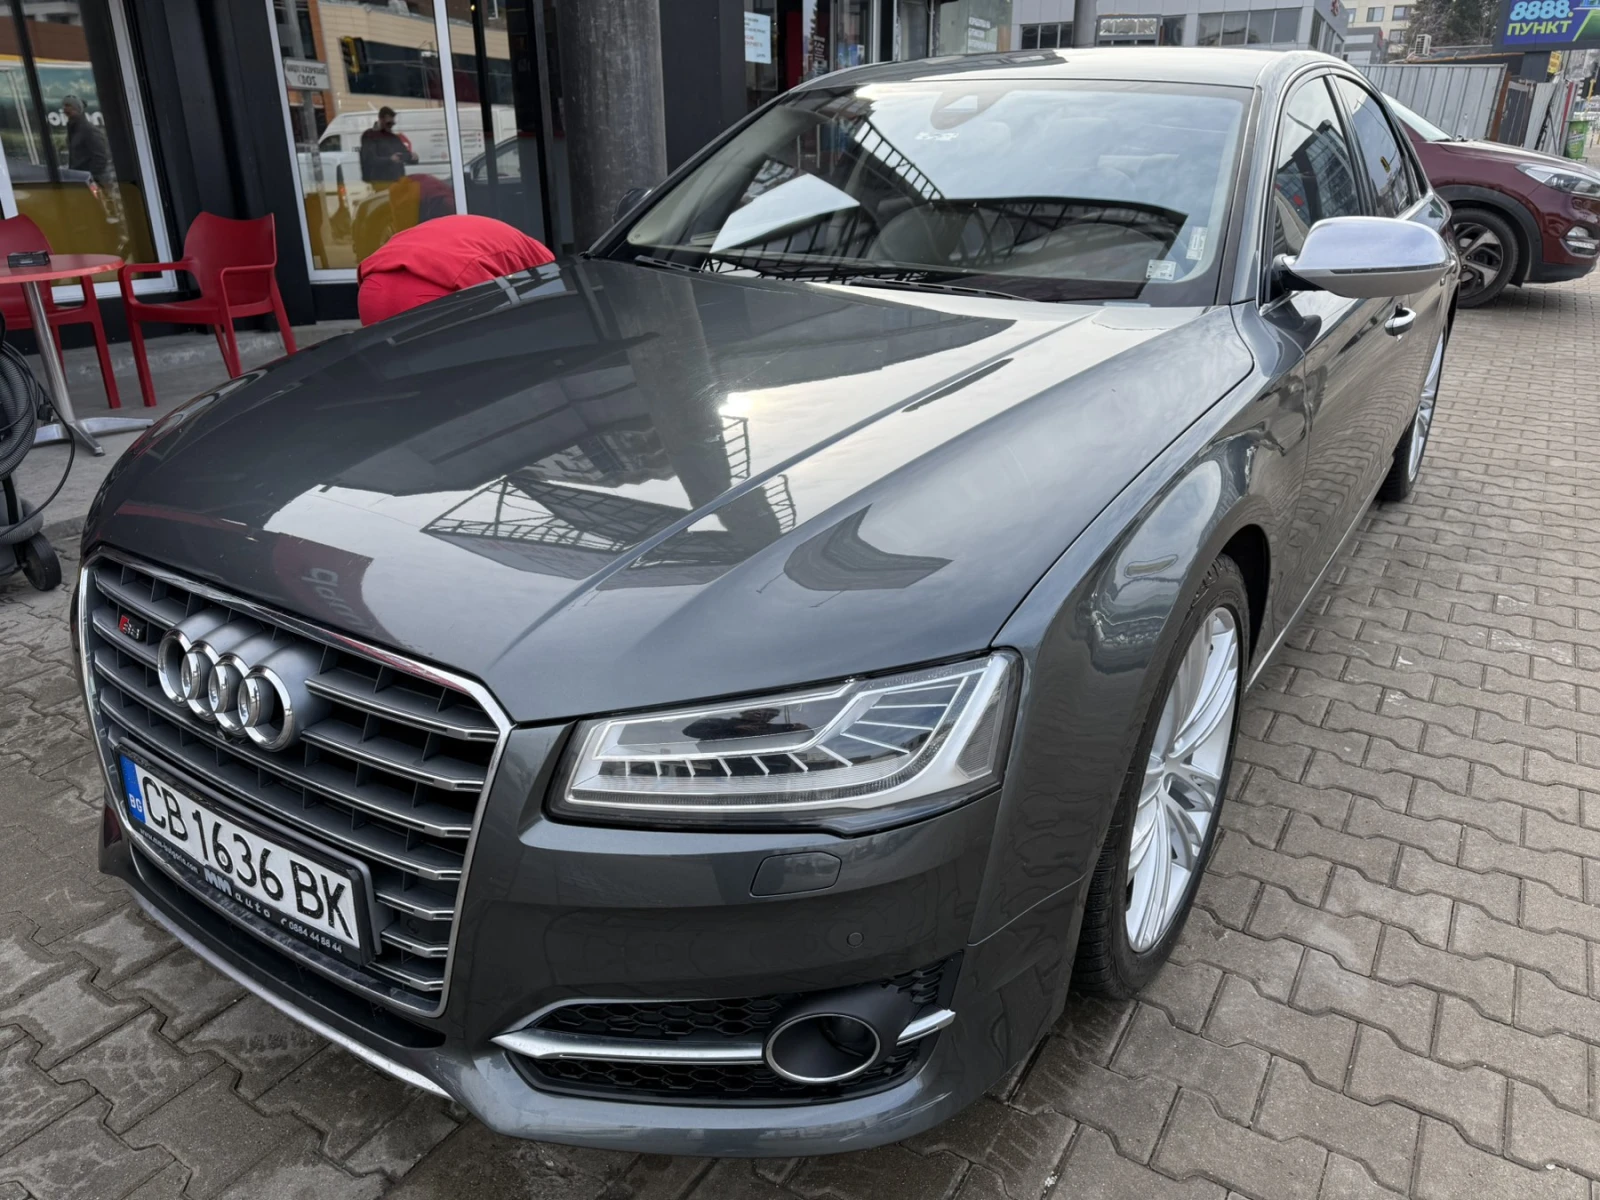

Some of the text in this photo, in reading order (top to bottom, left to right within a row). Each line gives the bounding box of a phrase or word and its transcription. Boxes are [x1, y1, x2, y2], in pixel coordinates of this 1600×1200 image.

[1507, 20, 1572, 36] ПУНКТ
[128, 793, 143, 813] BG
[234, 893, 271, 917] auto
